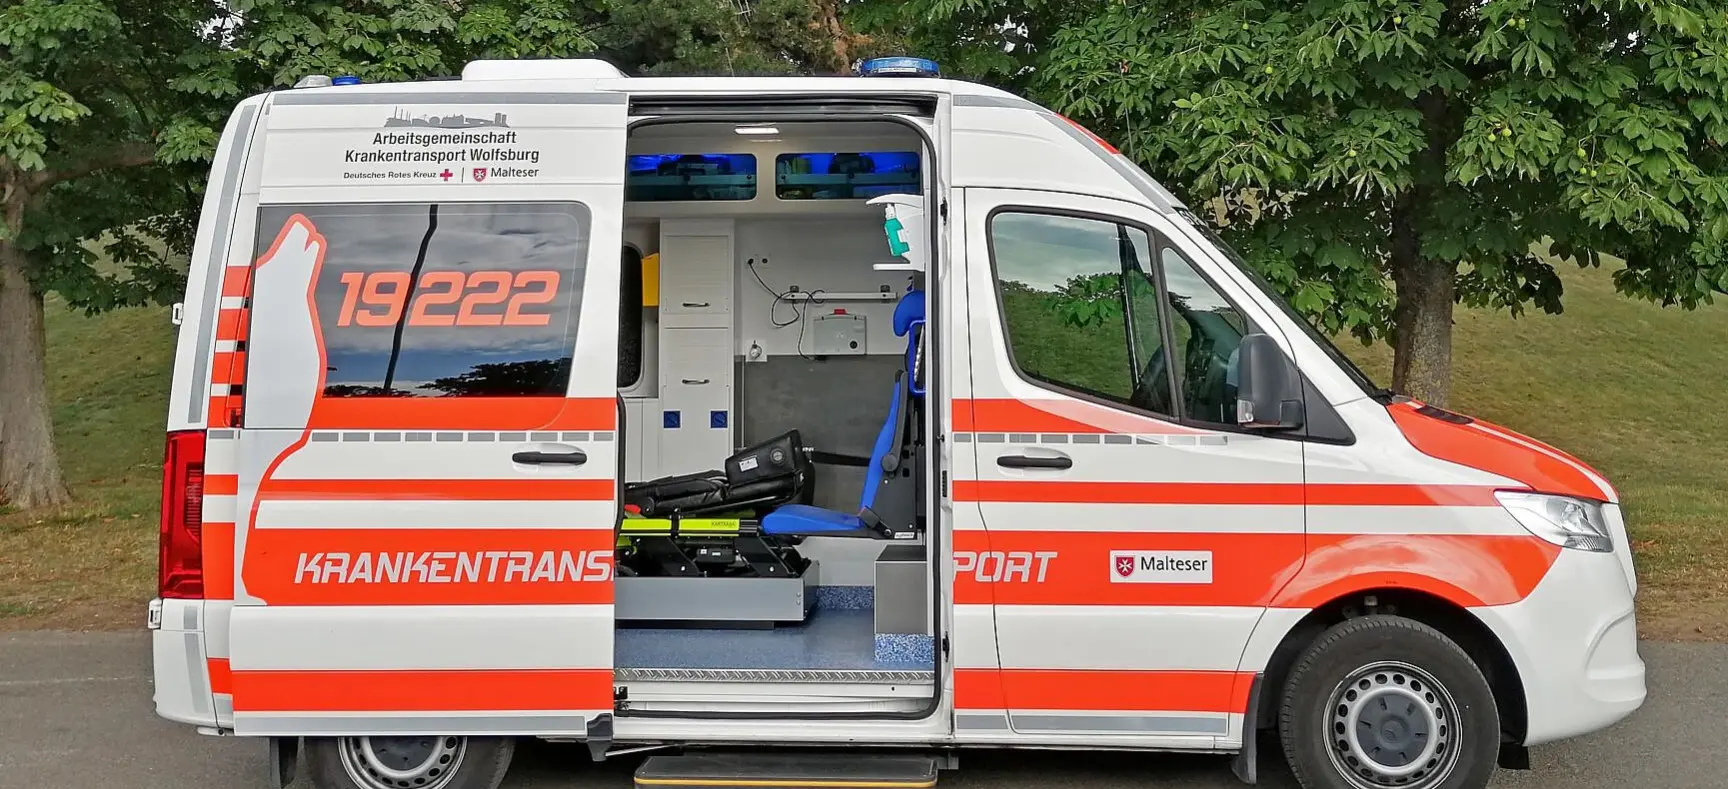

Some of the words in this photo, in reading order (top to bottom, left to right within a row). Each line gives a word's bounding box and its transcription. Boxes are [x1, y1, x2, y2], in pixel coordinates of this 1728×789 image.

[372, 131, 517, 147] Arbeitsgemeinschaft
[345, 149, 467, 165] Krankentransport
[470, 148, 540, 164] Wolfsburg
[343, 171, 386, 179] Deutsches
[388, 171, 412, 179] Rotes
[413, 171, 437, 179] Kreuz
[490, 166, 540, 178] Malteser
[295, 549, 614, 583] KRANKENTRANS
[953, 551, 1058, 583] PORT
[1140, 555, 1208, 571] Malteser
